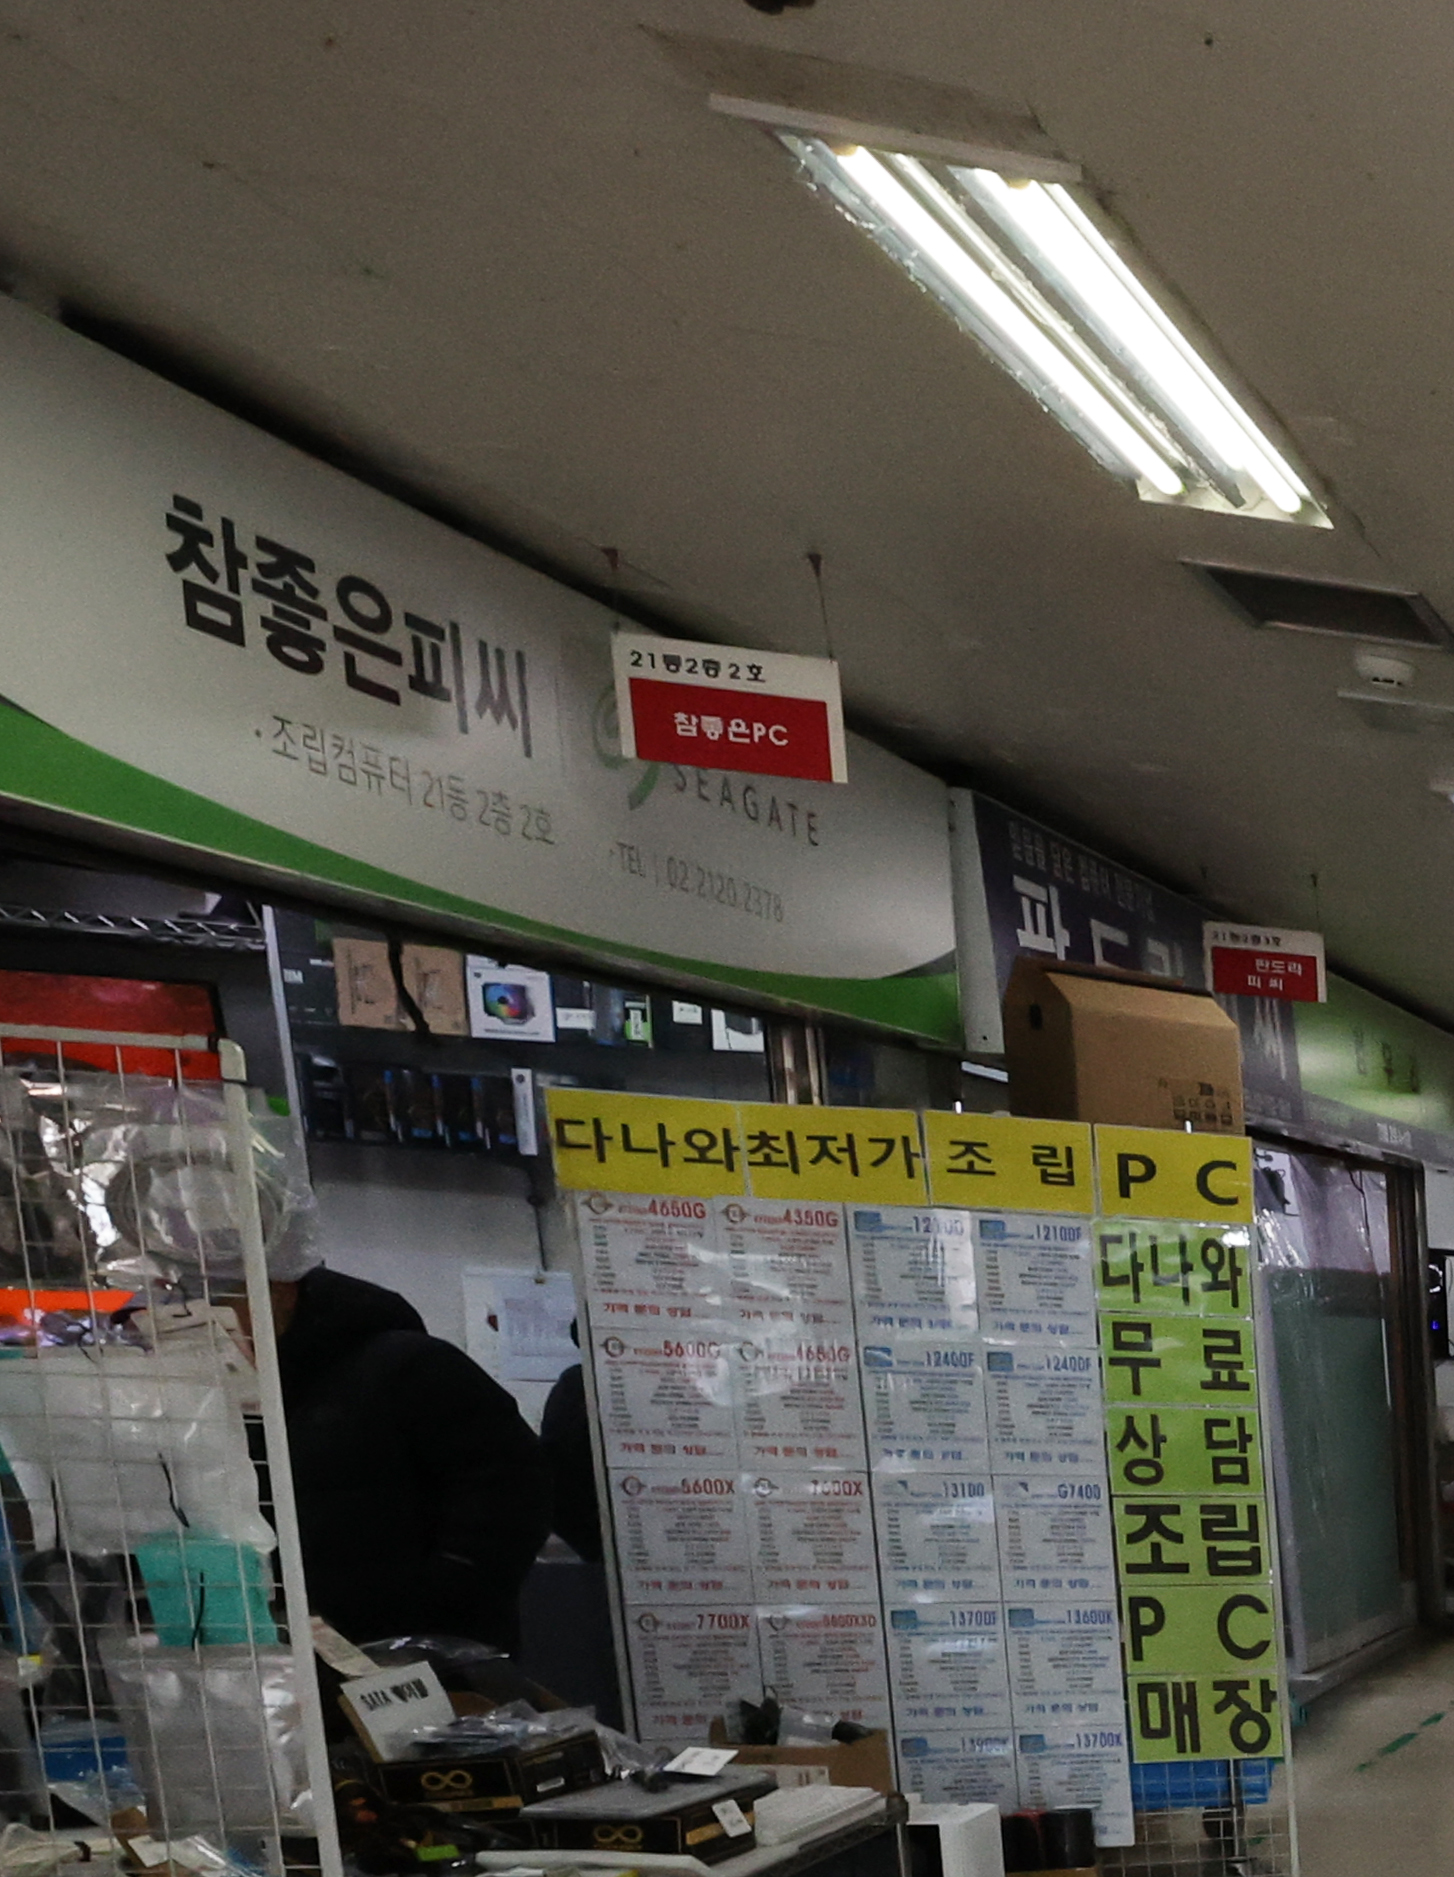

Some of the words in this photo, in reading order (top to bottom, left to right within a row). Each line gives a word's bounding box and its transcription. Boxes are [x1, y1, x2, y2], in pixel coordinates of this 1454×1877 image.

[165, 494, 532, 757] 참좋은피씨
[271, 714, 414, 808] 조립컴퓨터
[1101, 1232, 1243, 1309] 다나와
